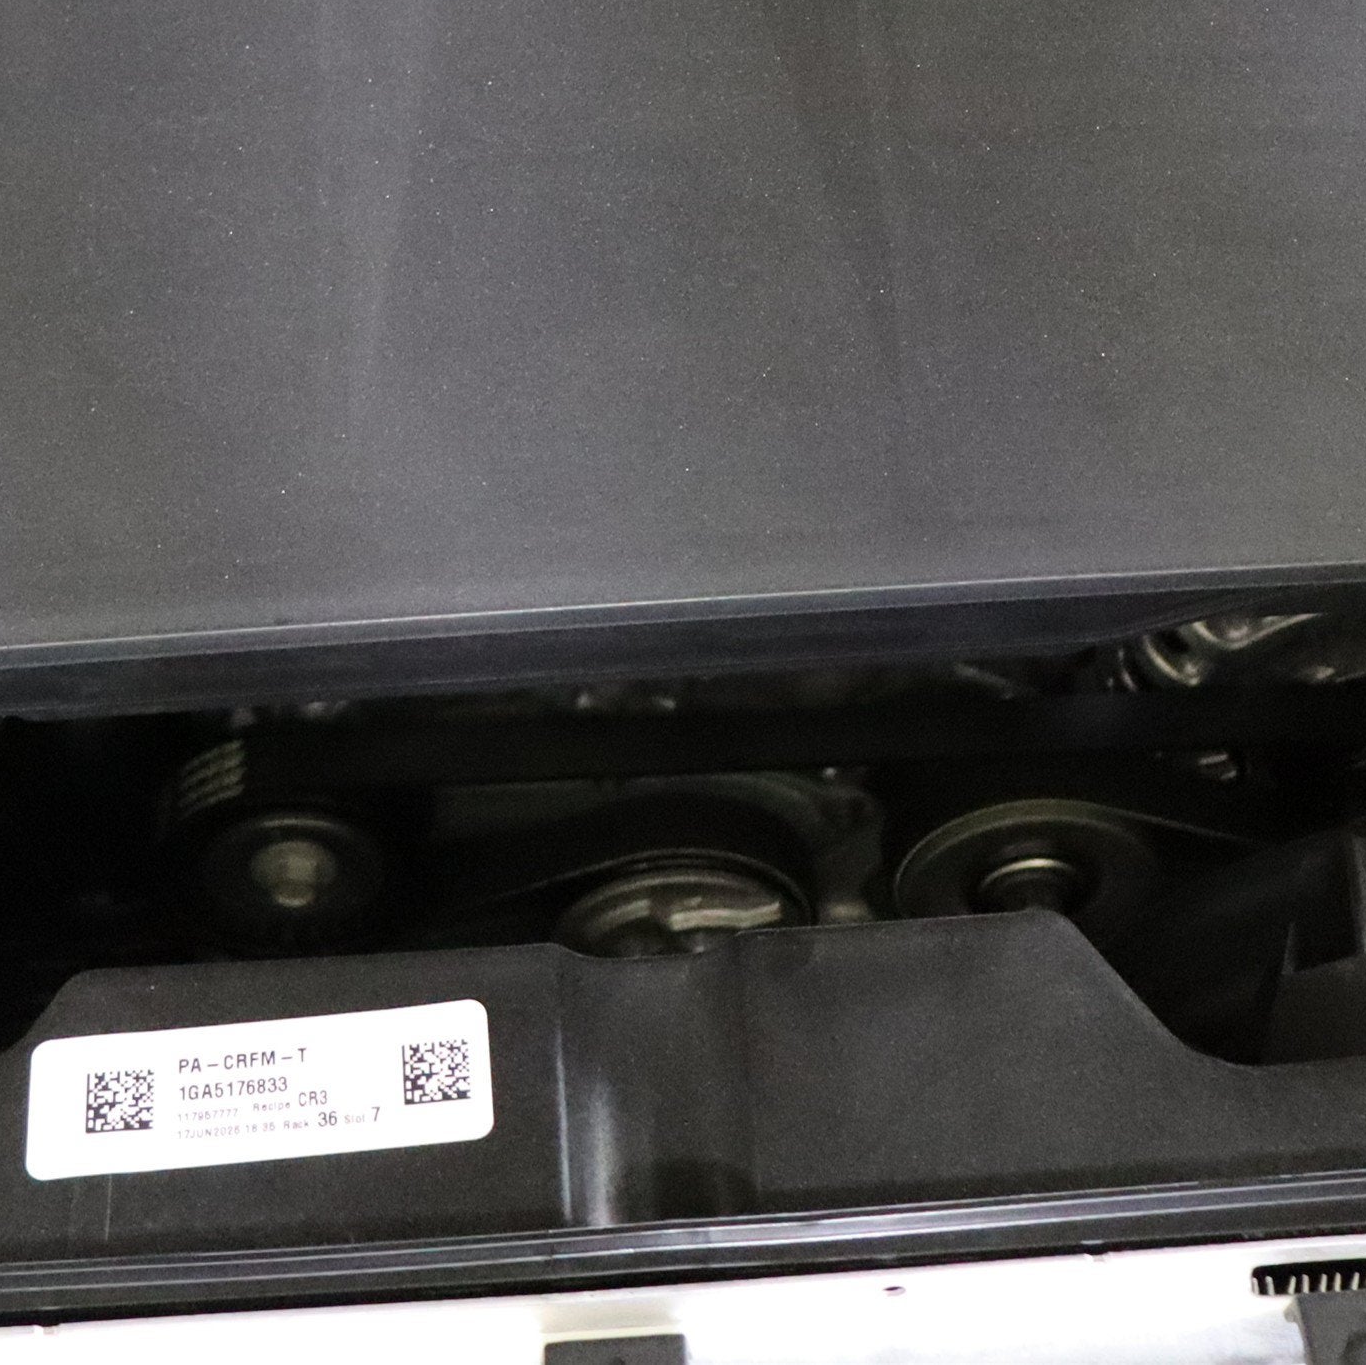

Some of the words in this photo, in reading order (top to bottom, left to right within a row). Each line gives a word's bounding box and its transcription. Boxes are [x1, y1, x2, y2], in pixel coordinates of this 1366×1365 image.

[178, 1076, 288, 1101] 1GA5176833
[298, 1089, 328, 1107] CR3
[317, 1110, 338, 1128] 36
[370, 1106, 381, 1123] 7
